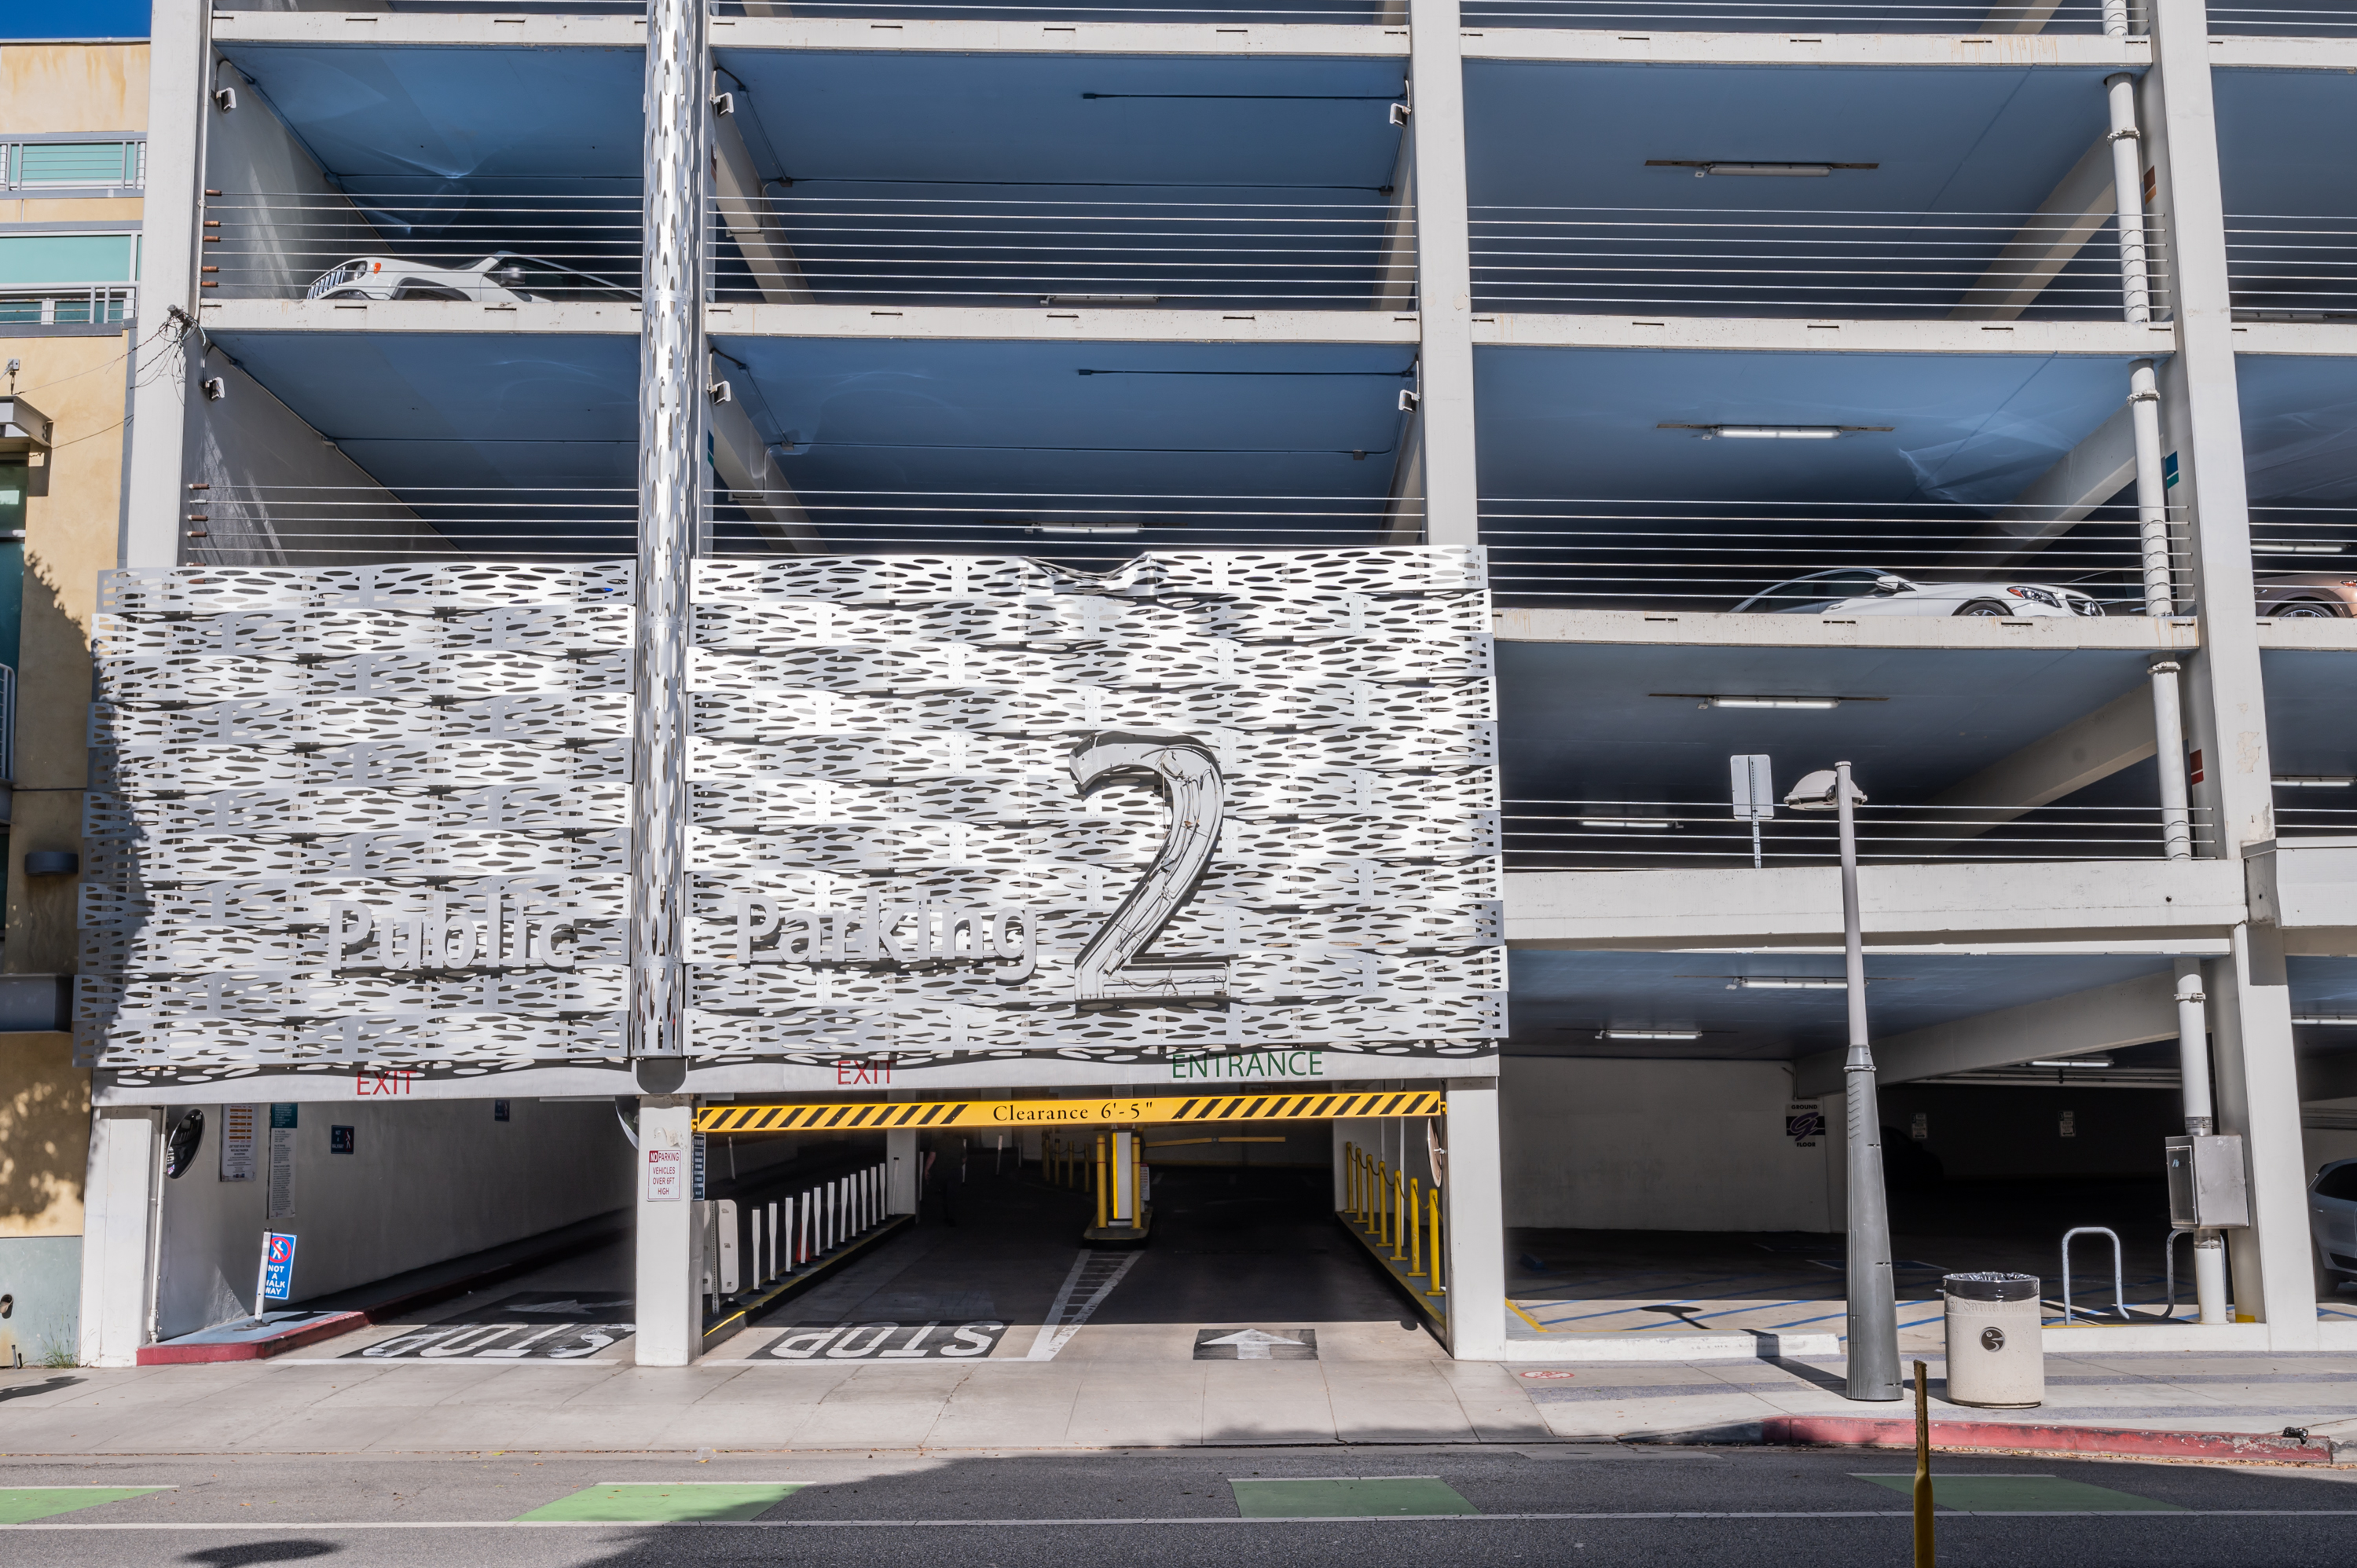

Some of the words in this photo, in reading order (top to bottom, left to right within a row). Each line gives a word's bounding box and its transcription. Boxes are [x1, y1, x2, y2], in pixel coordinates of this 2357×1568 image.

[1069, 730, 1230, 1000] 2
[328, 892, 575, 971] Public
[737, 886, 1037, 985] Parking
[838, 1060, 896, 1085] EXIT
[1173, 1051, 1323, 1078] ENTRANCE
[357, 1069, 417, 1095] EXIT
[993, 1105, 1088, 1121] Clearance
[650, 1152, 658, 1162] NO
[658, 1152, 680, 1161] PARKING
[1963, 1300, 1999, 1312] Santa
[362, 1321, 636, 1358] STOP
[771, 1321, 1004, 1358] STOP
